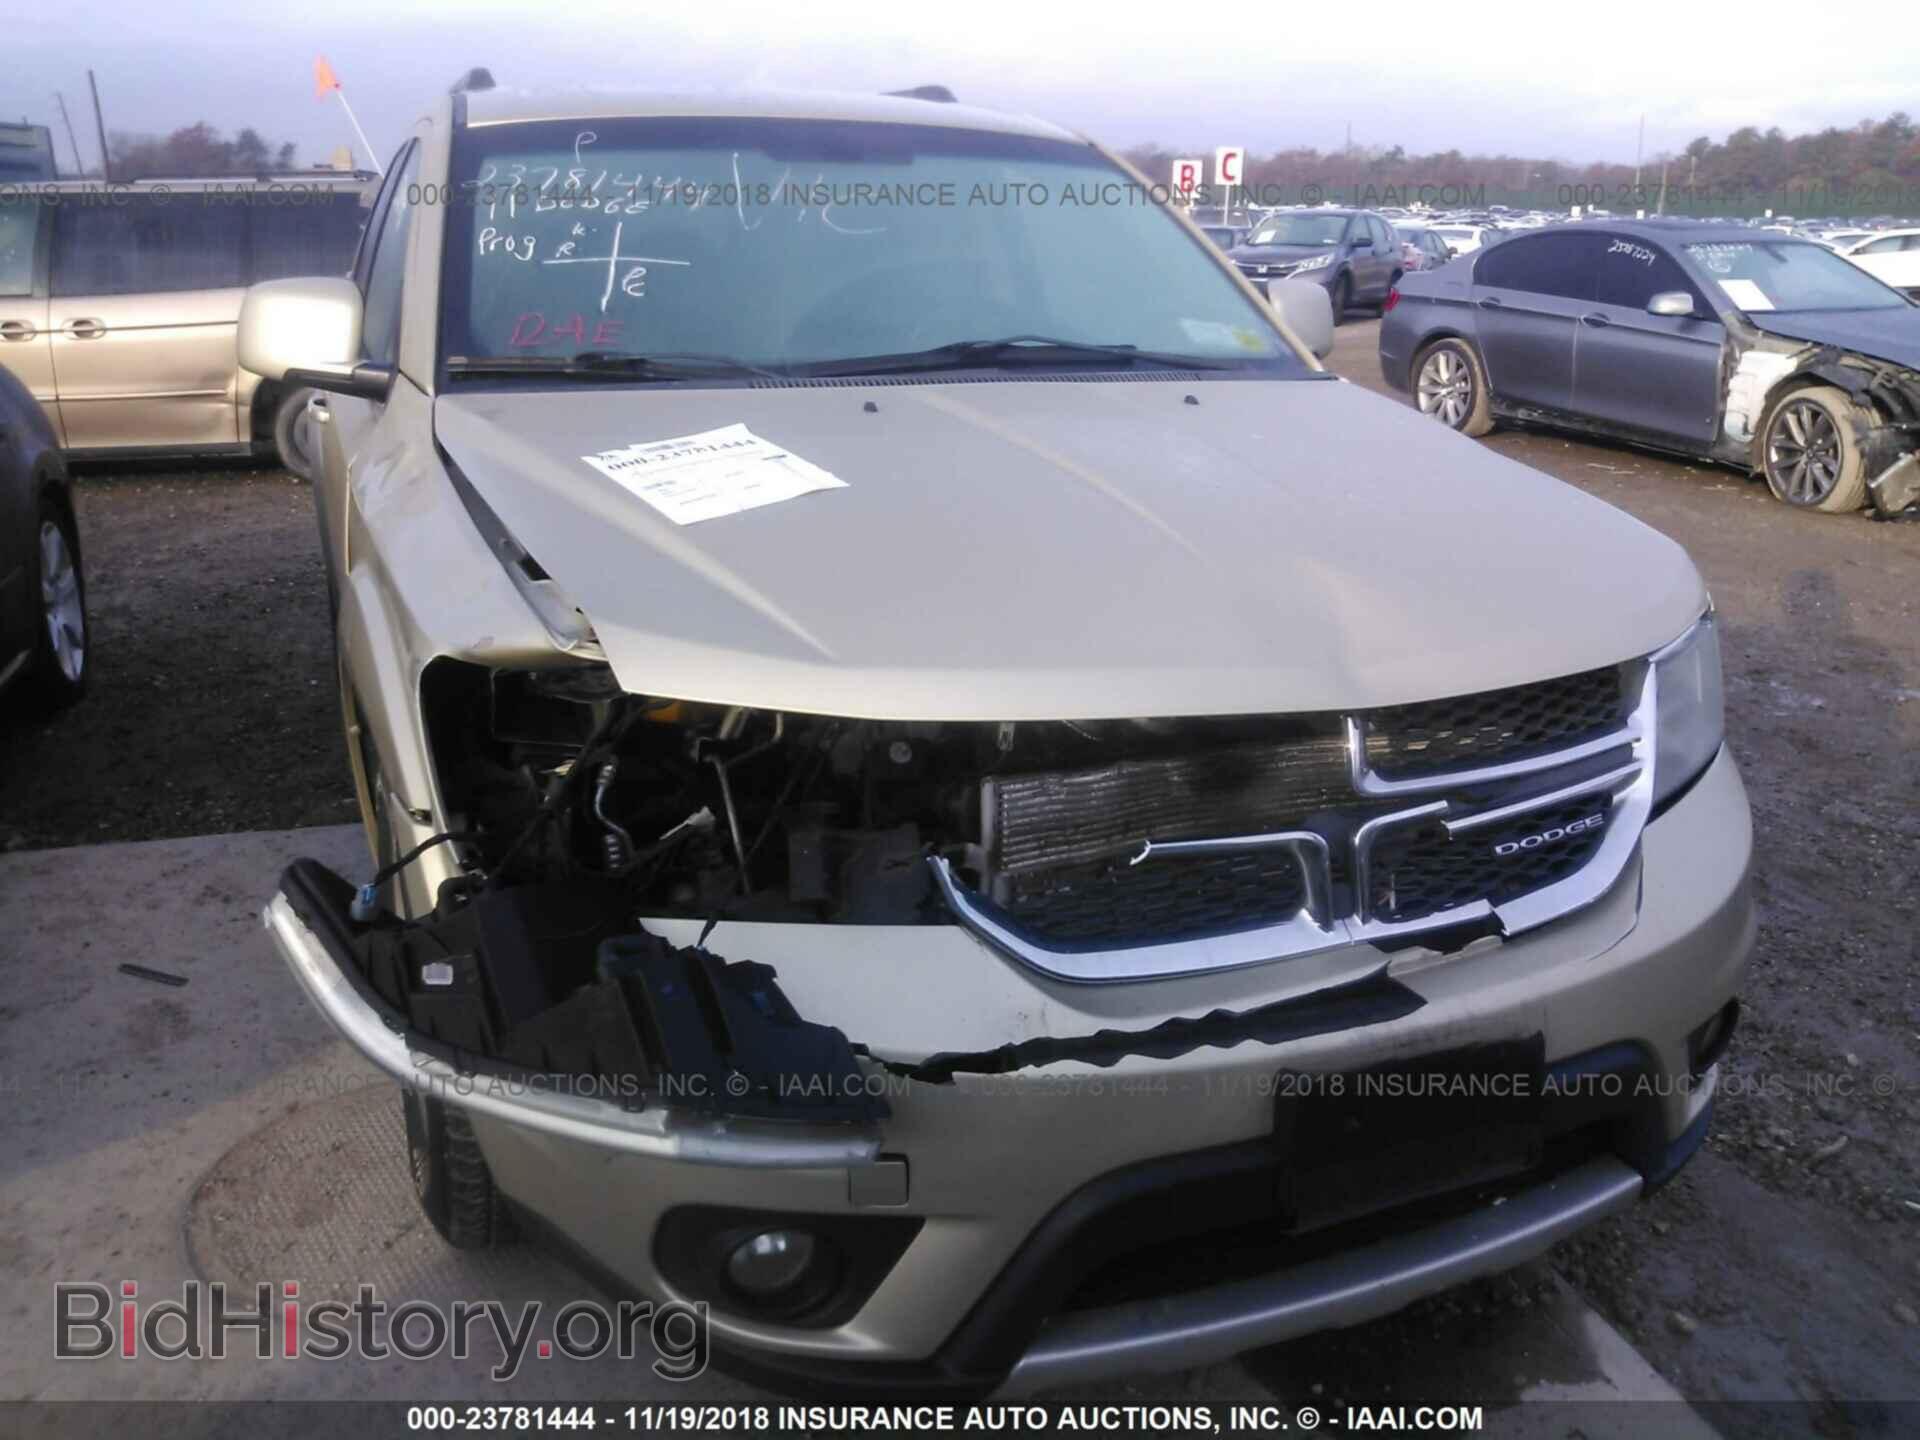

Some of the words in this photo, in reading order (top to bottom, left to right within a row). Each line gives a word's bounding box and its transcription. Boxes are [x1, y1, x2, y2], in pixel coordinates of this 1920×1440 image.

[1181, 164, 1194, 193] B
[1222, 153, 1237, 182] C
[1495, 813, 1605, 856] DODGE
